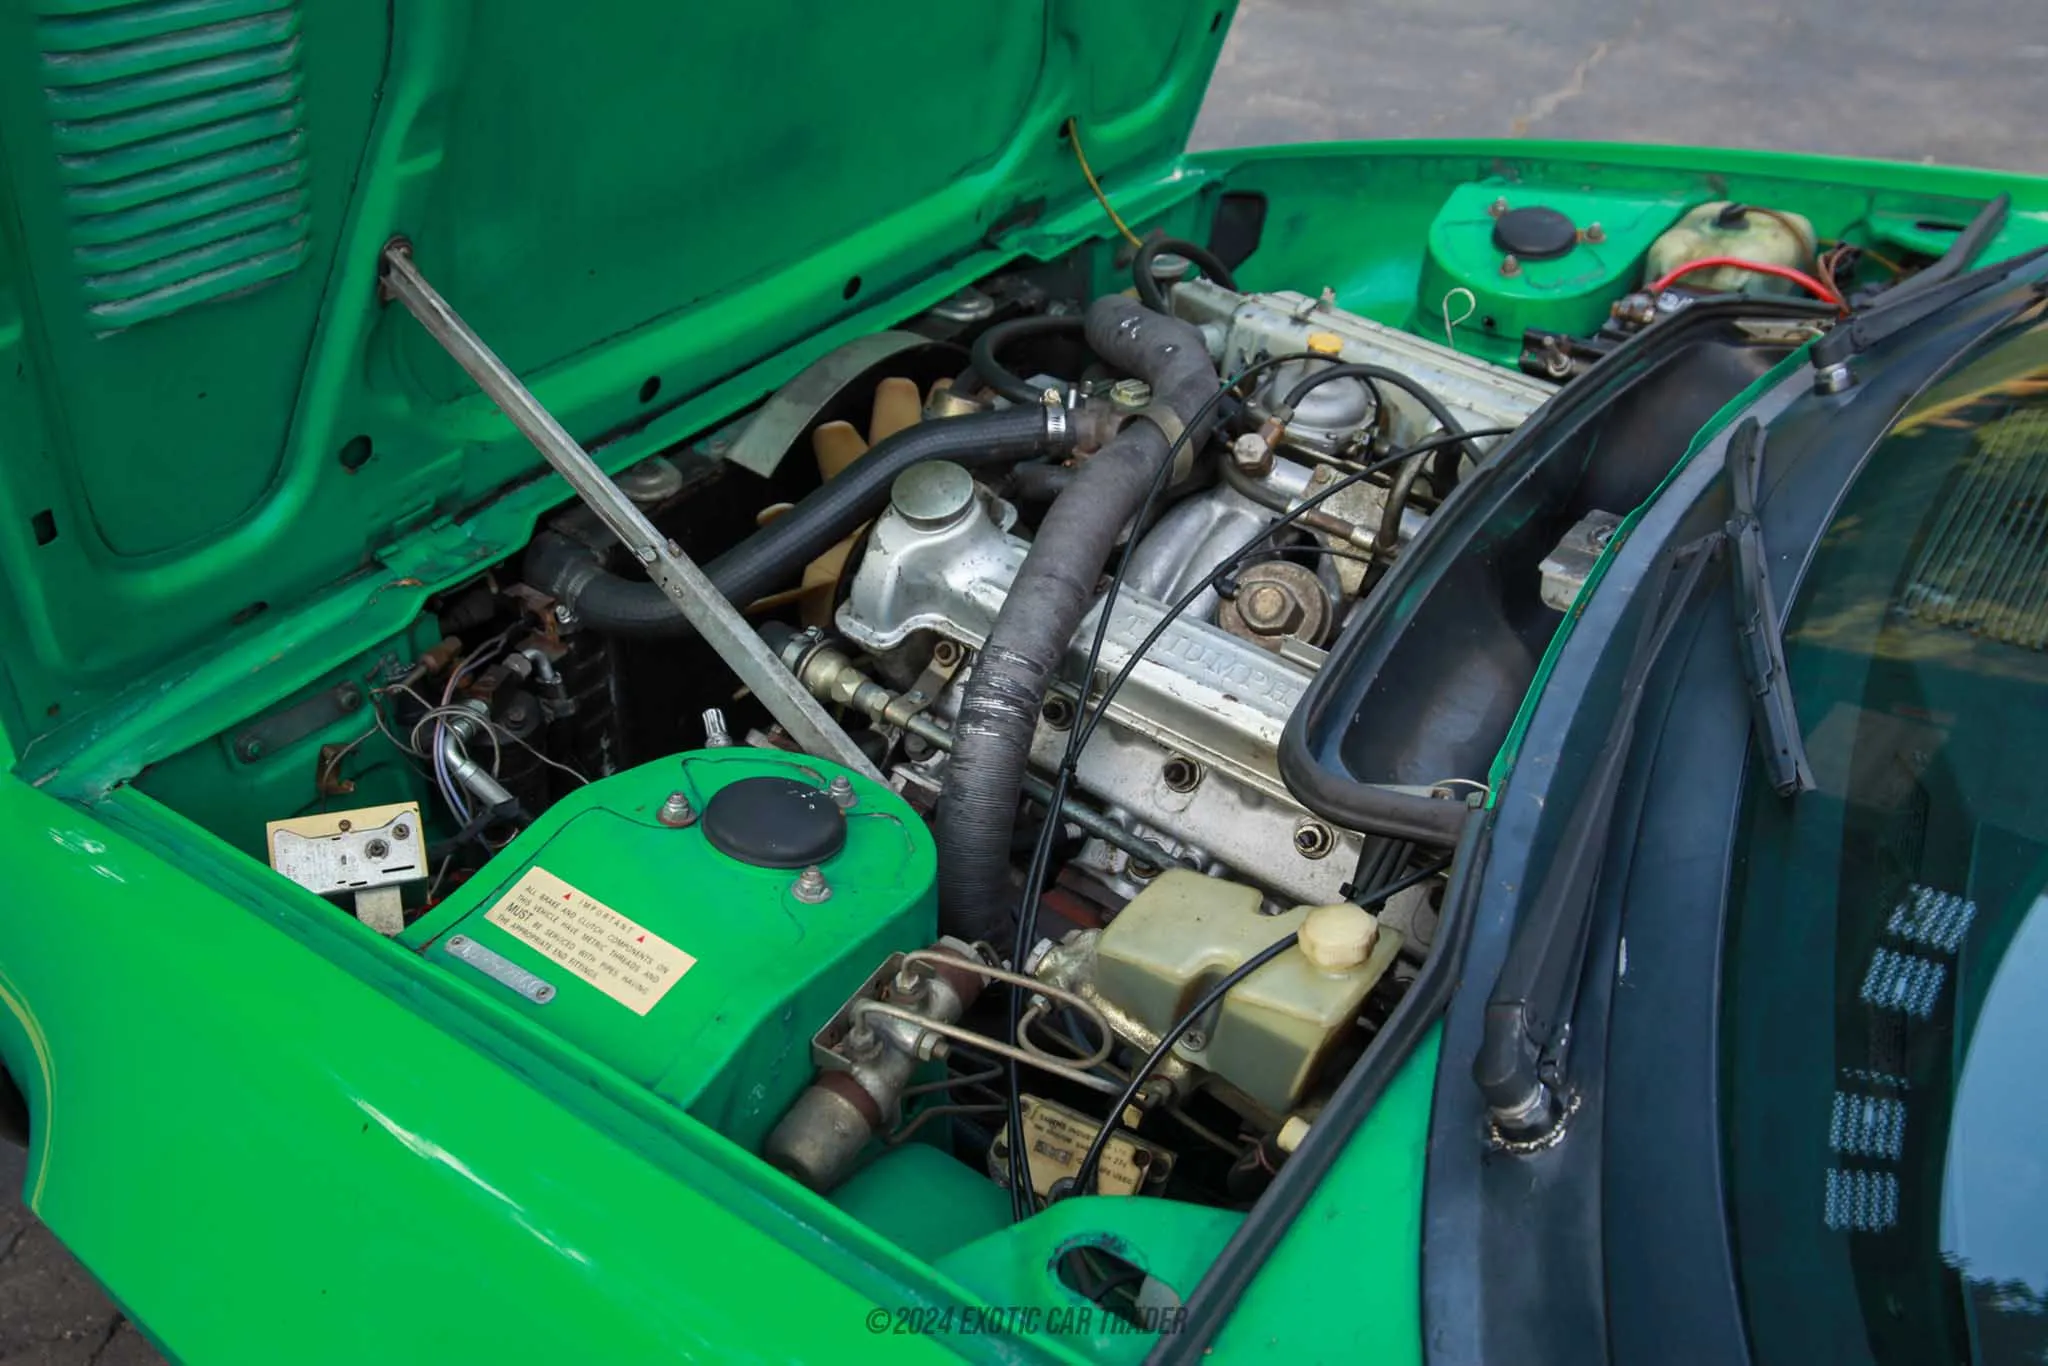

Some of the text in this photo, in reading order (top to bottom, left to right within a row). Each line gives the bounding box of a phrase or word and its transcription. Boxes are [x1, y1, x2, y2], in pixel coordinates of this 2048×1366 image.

[1123, 613, 1299, 706] TIUMPH
[496, 912, 511, 925] THE
[510, 921, 554, 952] APPROPRIATE
[552, 946, 569, 960] END
[505, 901, 534, 921] MUST
[532, 920, 543, 931] BE
[544, 928, 577, 951] SERVICED
[578, 948, 597, 963] WITH
[599, 960, 619, 978] PIPES
[517, 893, 660, 984] THIS VEHICLE HAVE METRIC THREADS AND
[524, 885, 670, 975] ALL BRAKE AND CLUTCH COMPONENTS ON
[578, 898, 634, 934] IMPORTANT
